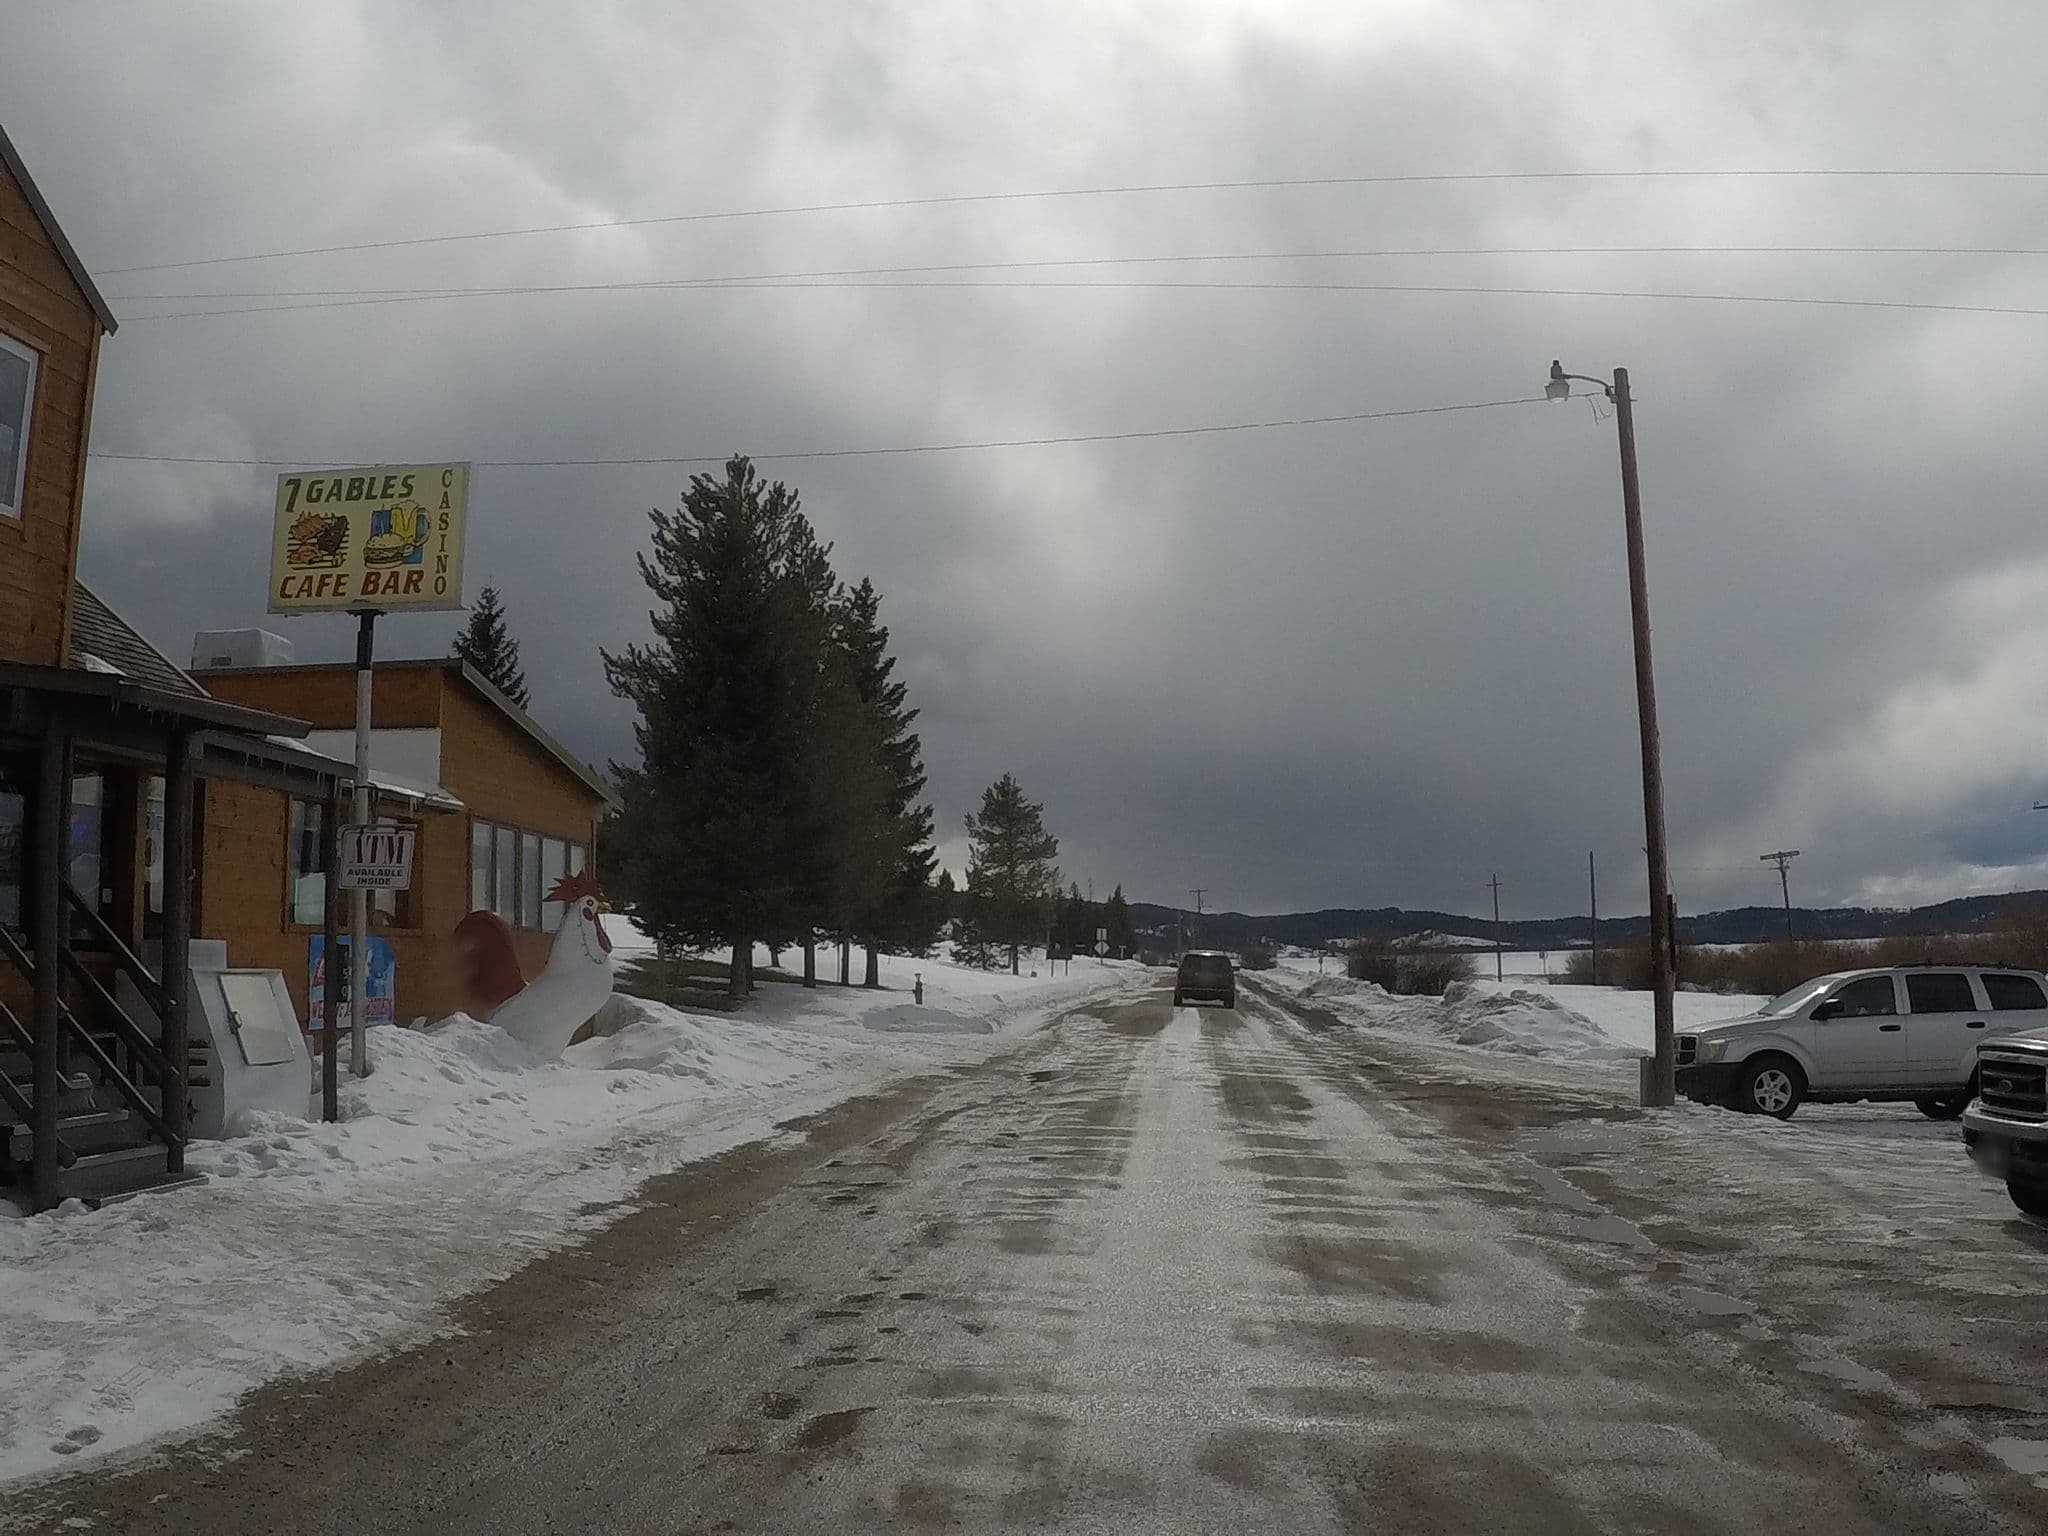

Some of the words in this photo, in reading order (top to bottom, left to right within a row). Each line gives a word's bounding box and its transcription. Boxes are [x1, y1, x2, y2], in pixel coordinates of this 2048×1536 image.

[284, 477, 302, 513] 7
[306, 474, 416, 503] GABLES
[434, 468, 453, 595] CASINO
[279, 573, 350, 599] CAFE
[360, 569, 425, 596] BAR
[347, 868, 403, 877] AVAILABLE
[356, 877, 391, 885] INSIDE
